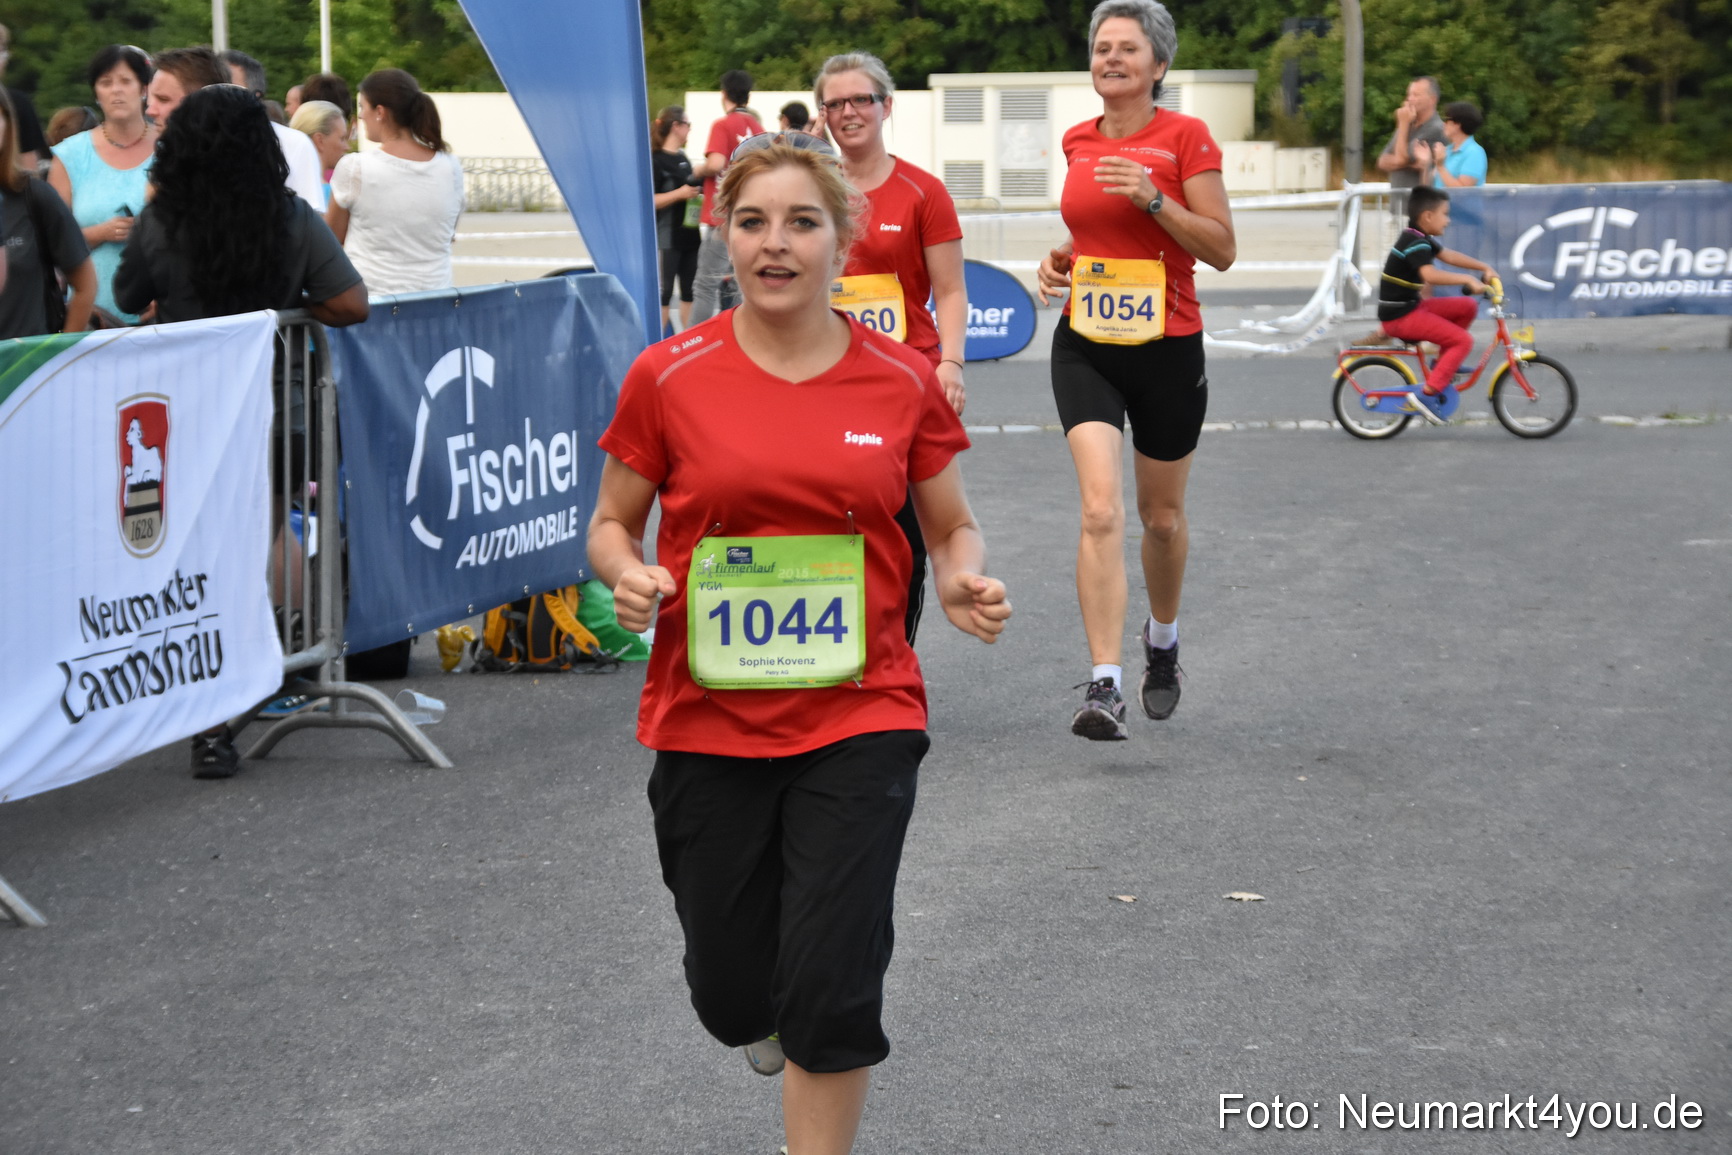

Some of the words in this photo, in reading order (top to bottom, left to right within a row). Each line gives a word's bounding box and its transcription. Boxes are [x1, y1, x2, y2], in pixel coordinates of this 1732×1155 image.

[1553, 238, 1732, 280] Fische
[1569, 280, 1732, 300] AUTOMOBILE
[1081, 291, 1155, 322] 1054
[846, 307, 896, 334] 60
[682, 335, 703, 349] JAKO
[844, 430, 883, 446] Sophie
[130, 517, 154, 542] 1628
[454, 505, 578, 569] AUTOMOBILE
[714, 562, 776, 573] firmenlauf
[708, 596, 849, 646] 1044
[739, 657, 776, 668] Sophie
[777, 656, 816, 666] Kovenz
